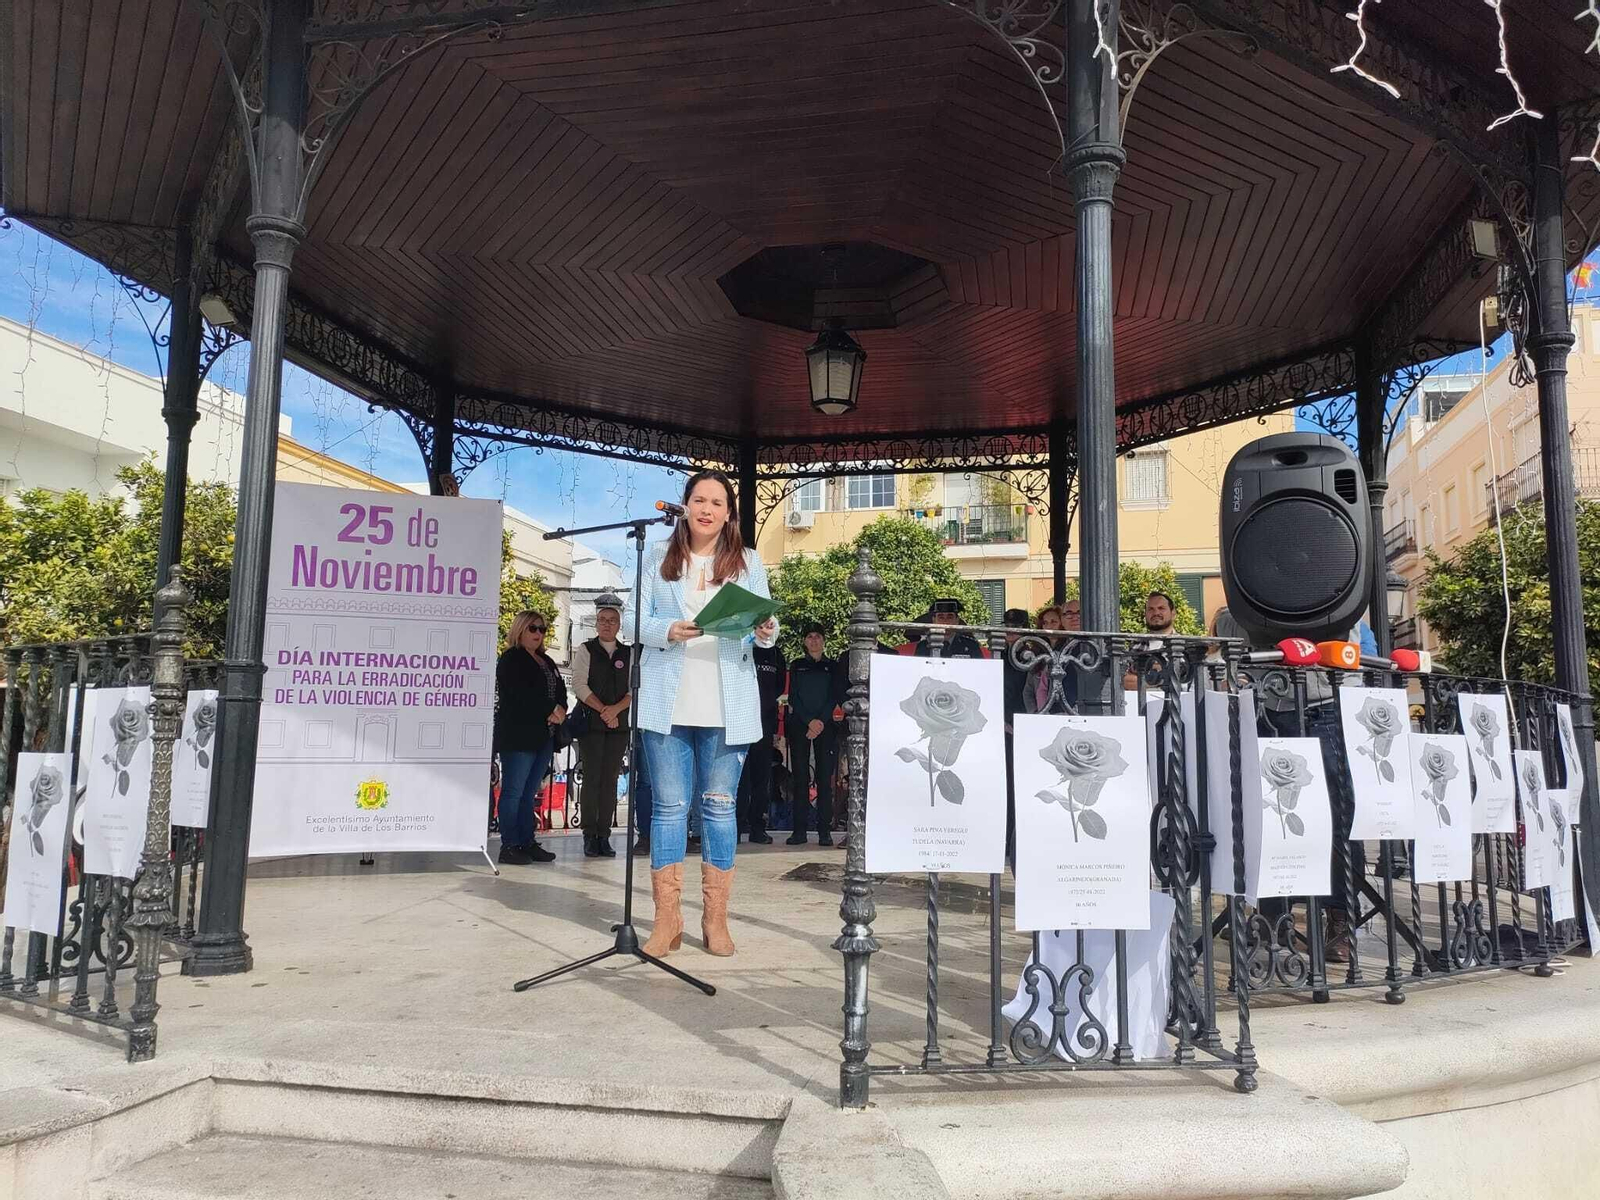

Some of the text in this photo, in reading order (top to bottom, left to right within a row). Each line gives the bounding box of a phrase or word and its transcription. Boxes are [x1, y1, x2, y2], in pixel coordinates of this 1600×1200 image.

[337, 503, 439, 548] 25 de
[291, 544, 478, 596] Noviembre
[277, 646, 480, 671] DÍA INTERNACIONAL
[292, 670, 464, 689] PARA LA ERRADICACIÓN
[275, 688, 477, 707] DE LA VIOLENCIA DE GÉNERO
[312, 825, 325, 833] de
[339, 824, 359, 833] Villa
[361, 823, 373, 832] de
[375, 823, 392, 832] Los
[394, 822, 428, 832] Barrios
[372, 814, 435, 824] Ayuntamiento
